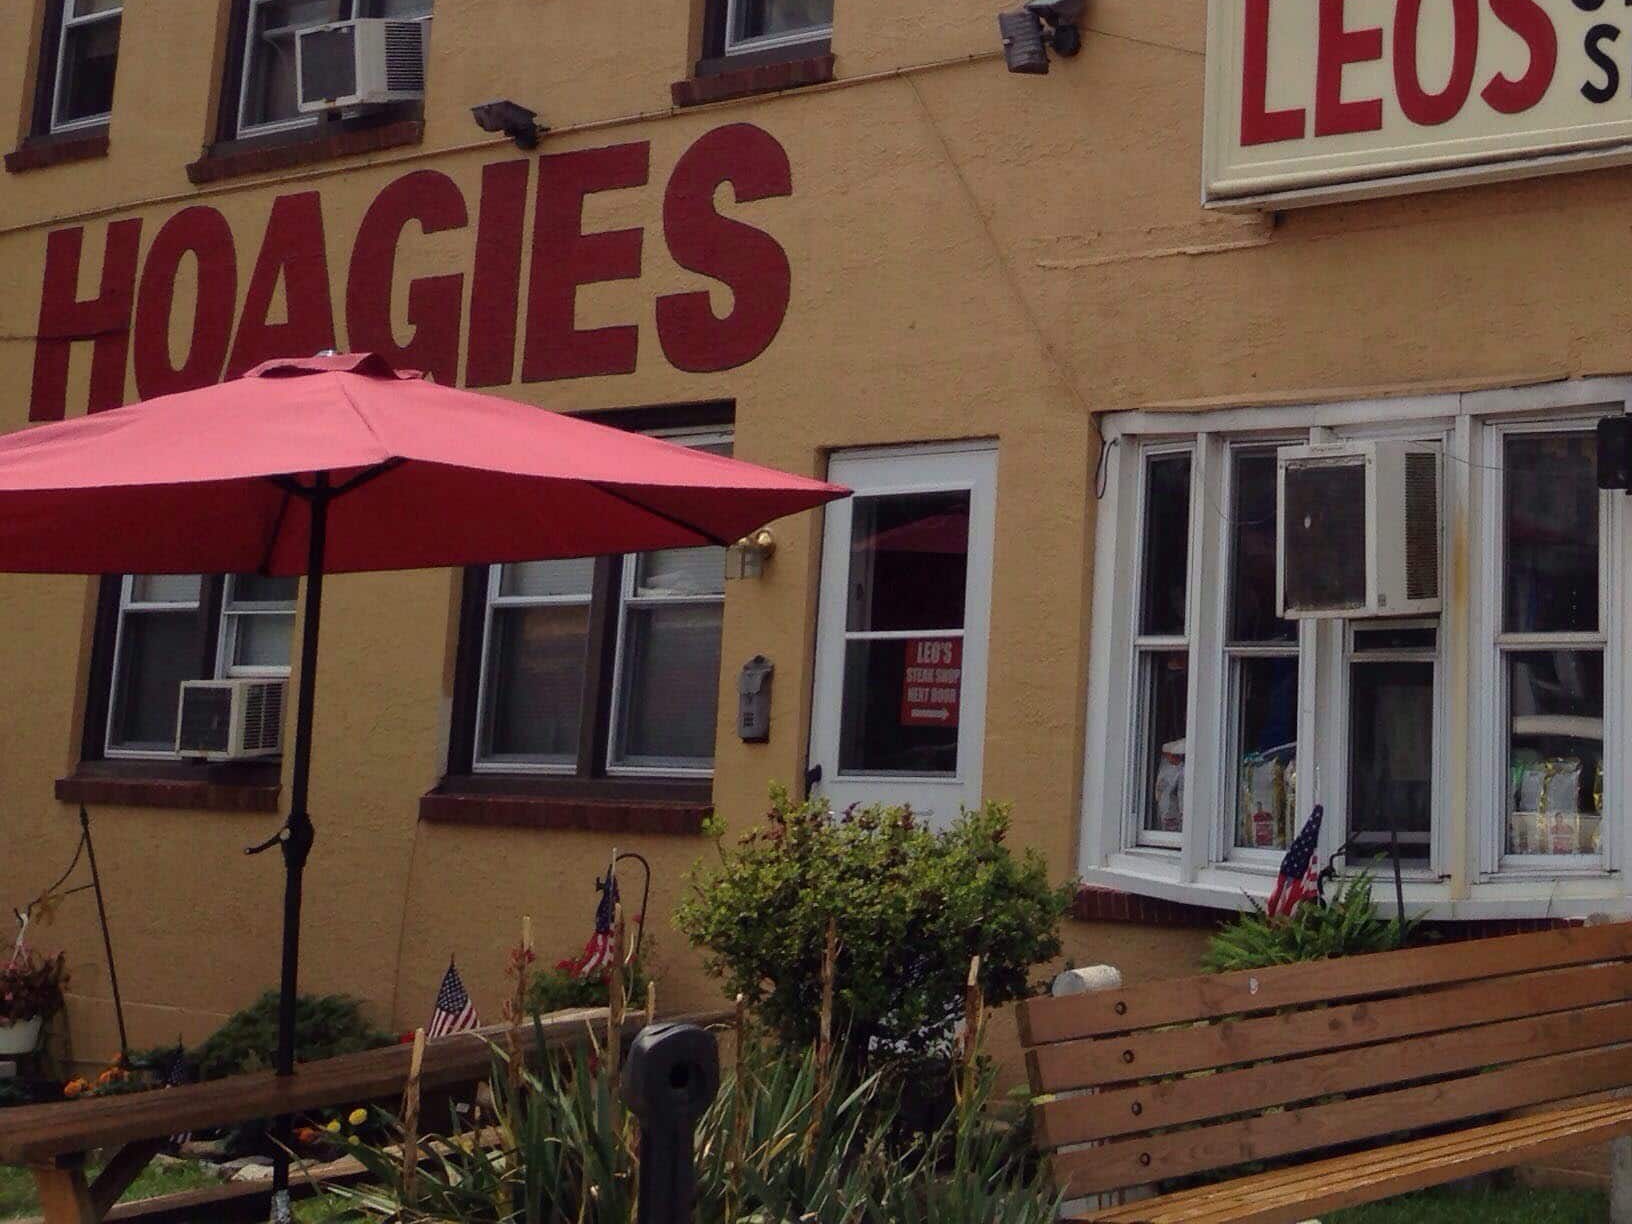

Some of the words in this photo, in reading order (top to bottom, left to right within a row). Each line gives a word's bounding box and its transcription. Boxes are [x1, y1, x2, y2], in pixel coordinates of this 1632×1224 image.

[29, 122, 794, 423] HOAGIES
[916, 641, 953, 665] LEO'S
[906, 667, 935, 684] STEAK
[906, 686, 930, 703] NEXT
